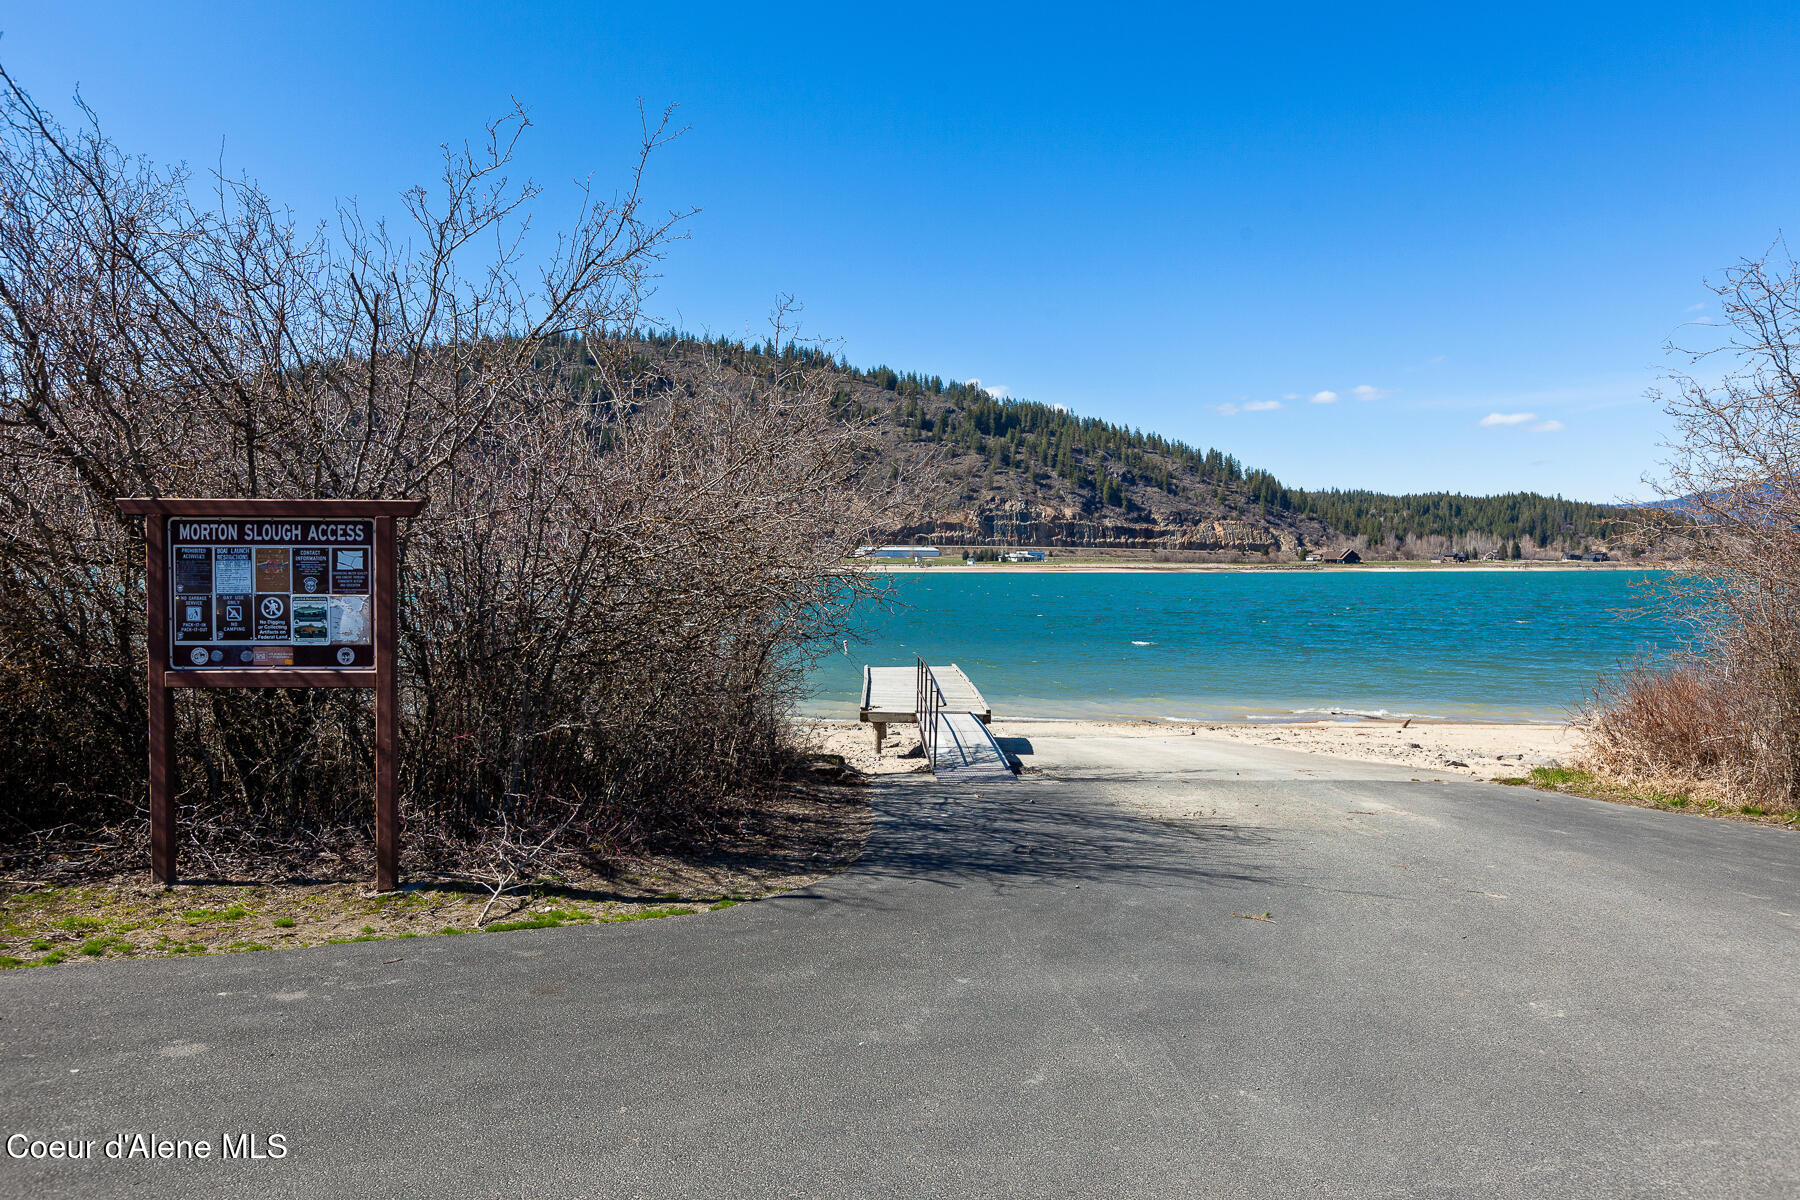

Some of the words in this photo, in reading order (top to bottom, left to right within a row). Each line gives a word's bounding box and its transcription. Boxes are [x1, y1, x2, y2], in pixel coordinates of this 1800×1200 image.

[179, 523, 238, 541] MORTON
[244, 524, 302, 541] SLOUGH
[307, 524, 364, 541] ACCESS
